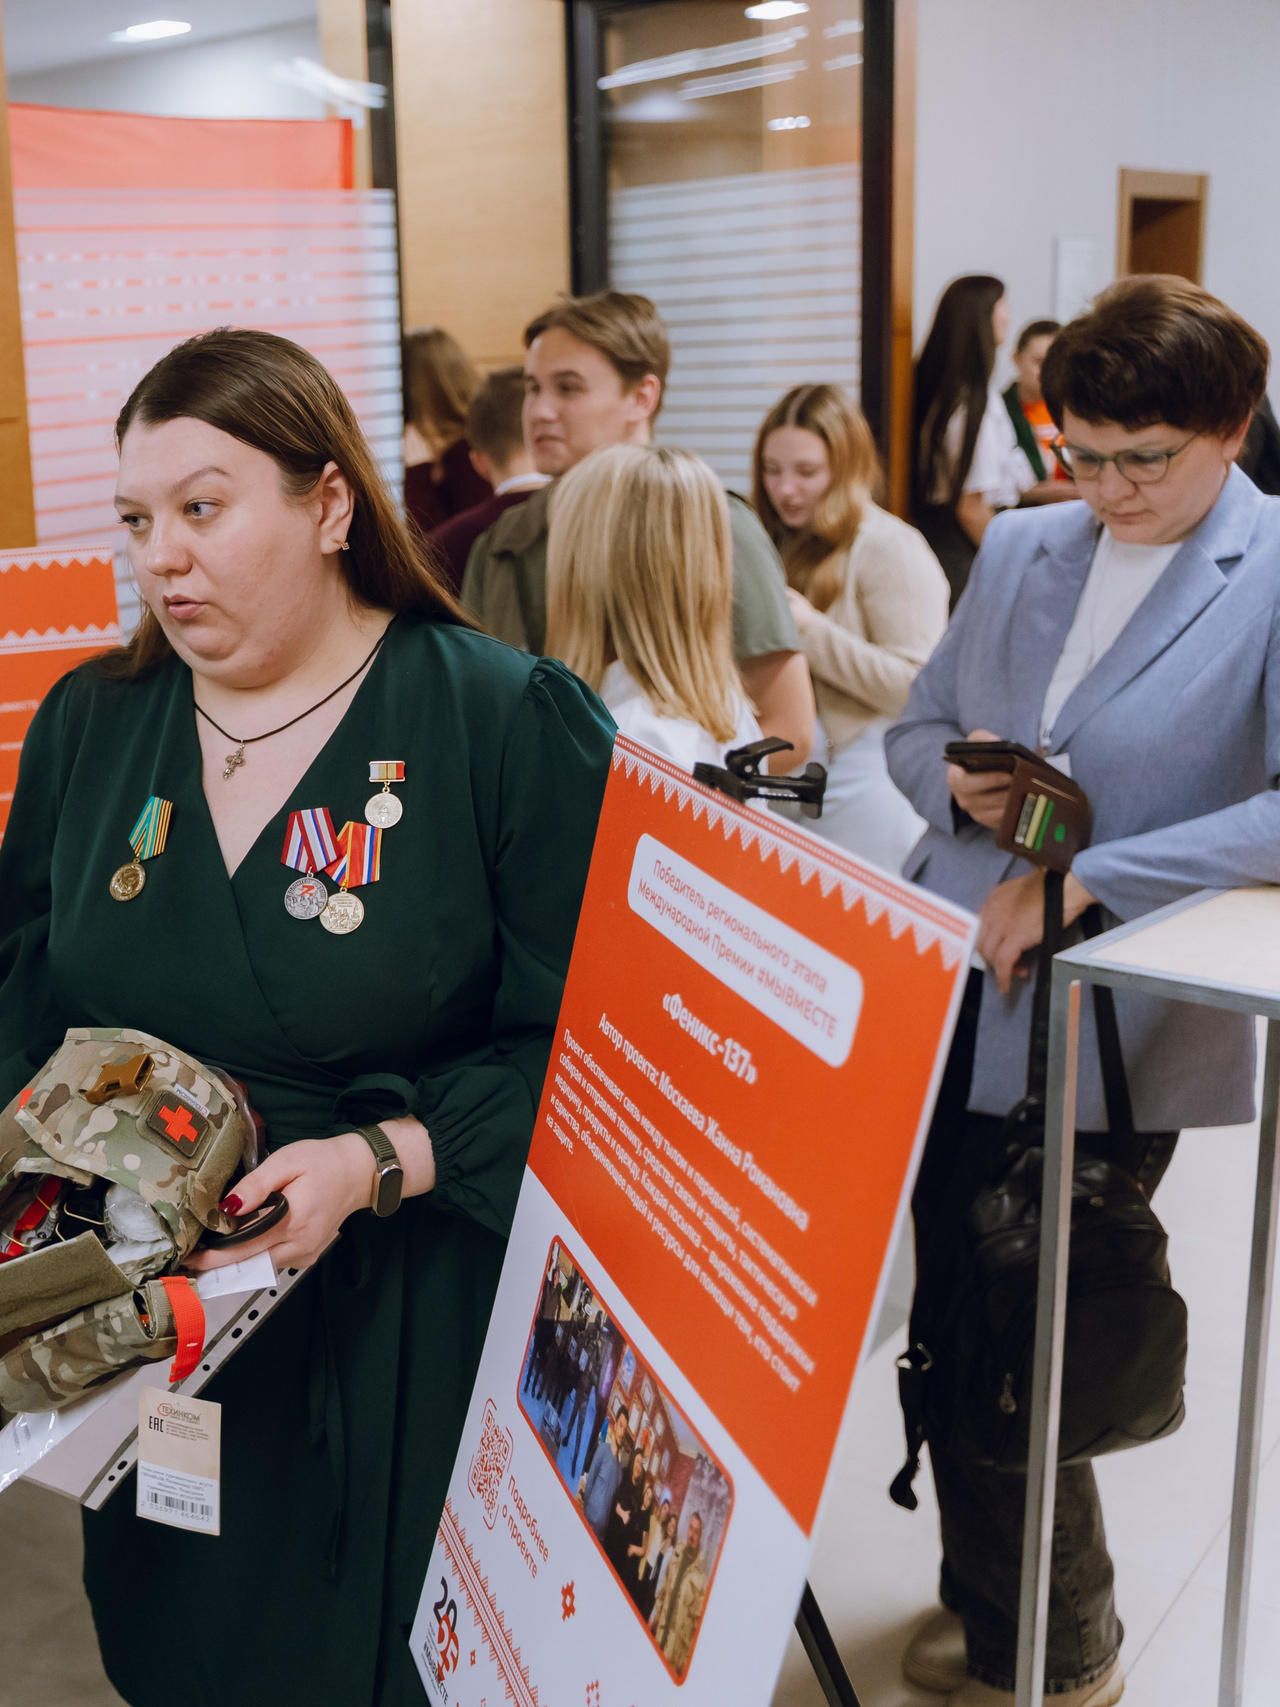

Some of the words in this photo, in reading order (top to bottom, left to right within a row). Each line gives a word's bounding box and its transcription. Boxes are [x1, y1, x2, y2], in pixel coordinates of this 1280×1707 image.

[638, 878, 710, 945] Международной
[712, 934, 755, 977] Премии
[757, 968, 837, 1038] #МЫВМЕСТЕ
[654, 859, 705, 910] Победитель
[706, 902, 790, 967] регионального
[792, 959, 826, 994] этапа
[663, 994, 757, 1084] «Феникс-137»
[546, 1114, 553, 1128] на
[553, 1122, 573, 1154] защите.
[551, 1094, 555, 1104] и
[554, 1099, 580, 1138] единства,
[581, 1130, 626, 1190] объединяющее
[625, 1184, 648, 1216] людей
[647, 1209, 653, 1223] и
[652, 1215, 684, 1260] ресурсы
[683, 1252, 700, 1278] для
[555, 1073, 582, 1114] медицину,
[583, 1105, 611, 1144] продукты
[610, 1138, 616, 1150] и
[616, 1144, 640, 1180] одежду.
[641, 1170, 668, 1210] Каждая
[667, 1204, 701, 1248] посылка
[560, 1053, 582, 1084] собирая
[581, 1078, 586, 1089] и
[586, 1083, 617, 1123] отправляя
[616, 1115, 642, 1156] технику,
[643, 1147, 675, 1188] средства
[674, 1182, 697, 1212] связи
[696, 1204, 704, 1220] и
[703, 1212, 737, 1260] защиты,
[564, 1029, 584, 1059] Проект
[584, 1054, 624, 1102] обеспечивает
[623, 1096, 641, 1122] связь
[640, 1116, 664, 1149] между
[664, 1139, 688, 1172] тылом
[687, 1165, 694, 1178] и
[693, 1171, 740, 1231] передовой,
[598, 1013, 623, 1051] Автор
[622, 1040, 659, 1086] проекта:
[658, 1071, 705, 1131] Москаева
[704, 1117, 742, 1166] Жанна
[741, 1152, 809, 1231] Романовна
[162, 1406, 200, 1421] ТЕХИНКОМ
[502, 1504, 507, 1518] о
[507, 1514, 537, 1579] проекте
[508, 1475, 548, 1562] Подробнее
